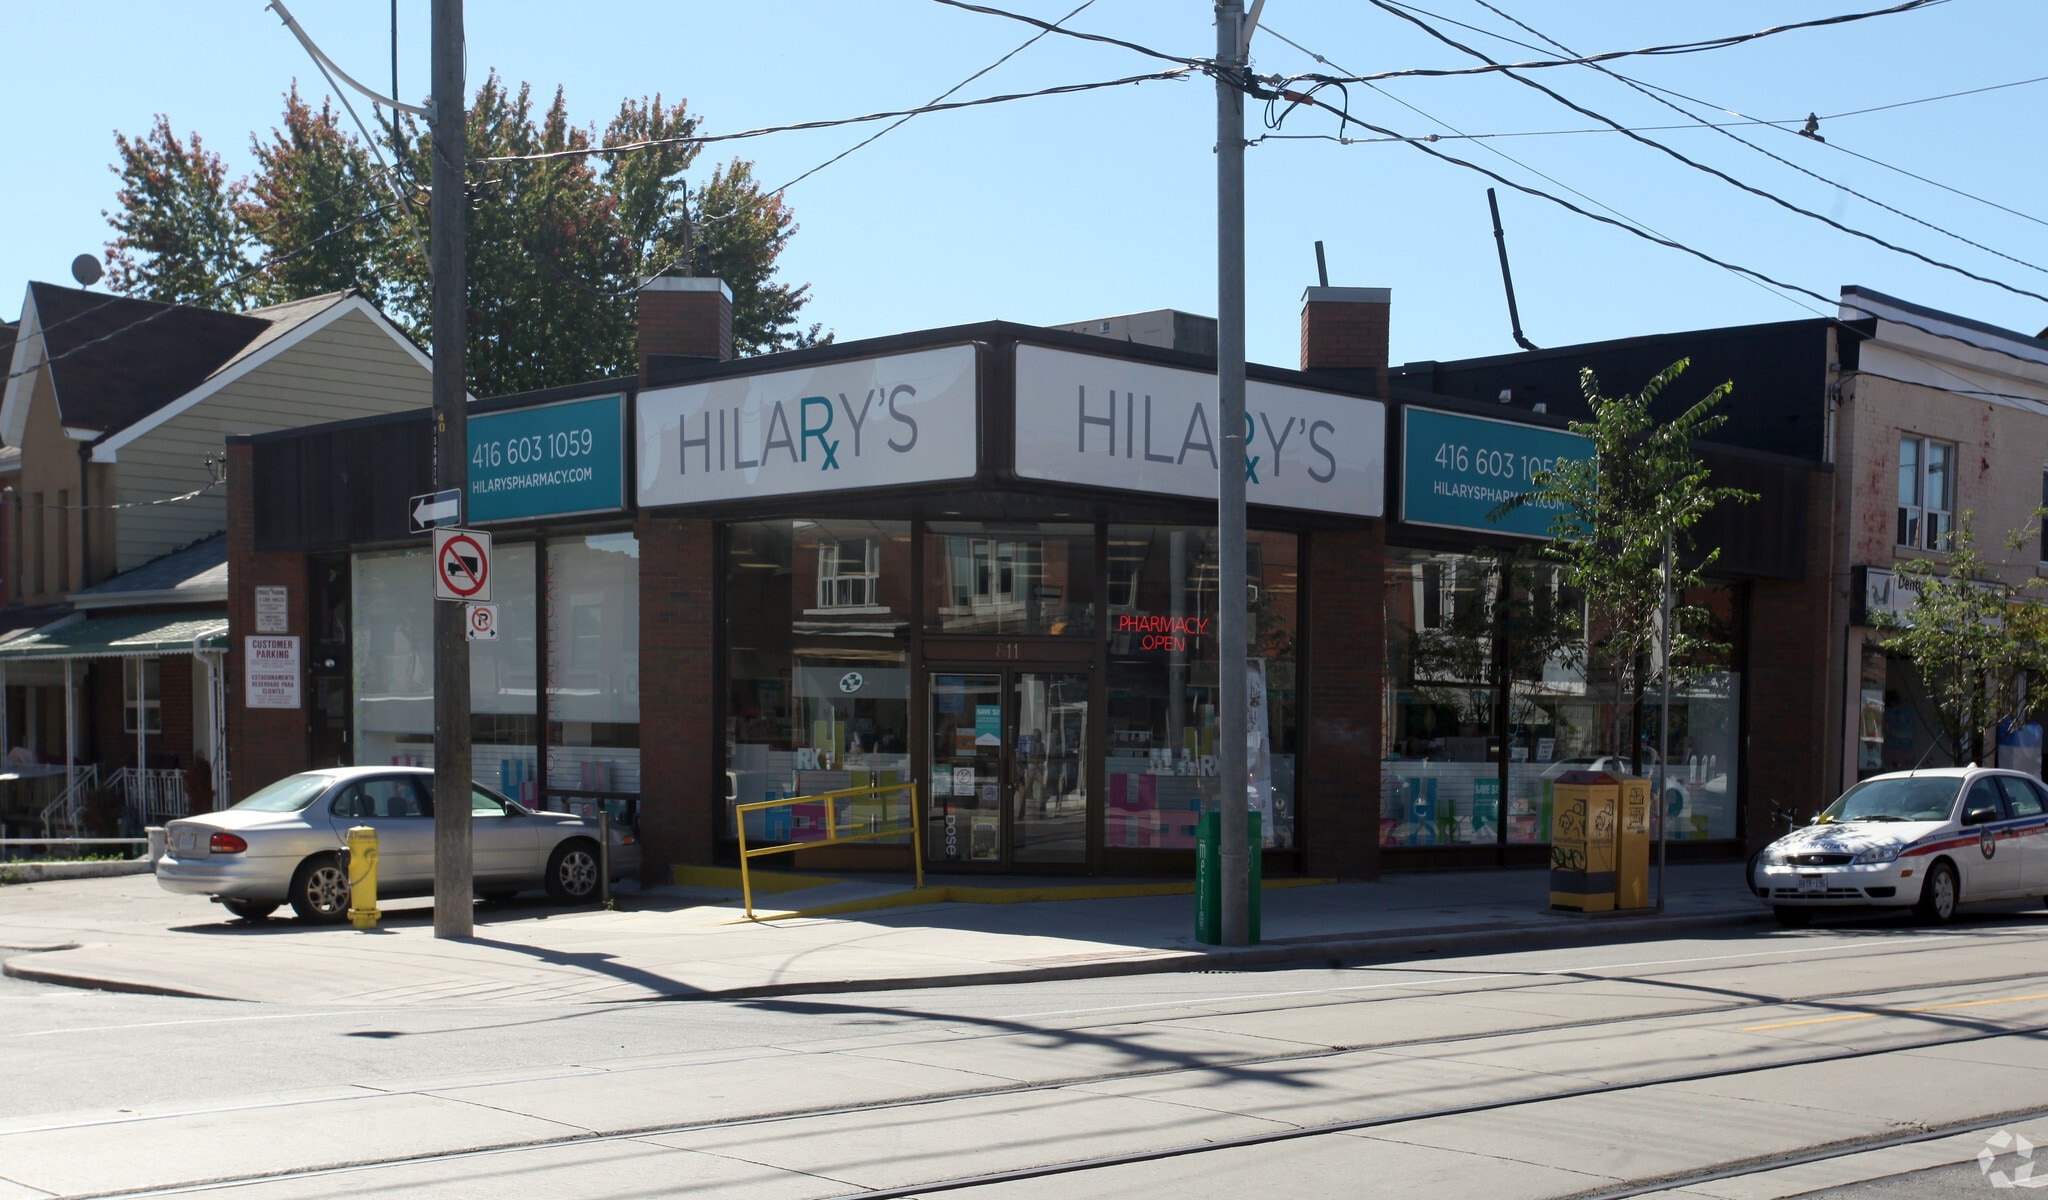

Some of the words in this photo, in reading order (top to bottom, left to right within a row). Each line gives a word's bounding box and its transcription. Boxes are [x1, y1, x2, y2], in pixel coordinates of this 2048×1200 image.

[1077, 384, 1337, 486] HILAY'S
[472, 437, 501, 469] 416
[507, 432, 543, 464] 603
[548, 428, 593, 459] 1059
[1434, 442, 1469, 472] 416
[1475, 448, 1515, 479] 603
[472, 467, 593, 495] HILARYSPHARMACY.COM
[1118, 615, 1208, 635] PHARMACY
[252, 639, 293, 649] CUSTOMER
[996, 643, 1019, 659] 811
[1142, 634, 1185, 652] OPEN
[256, 650, 289, 659] PARKING
[1475, 784, 1490, 795] SAVE
